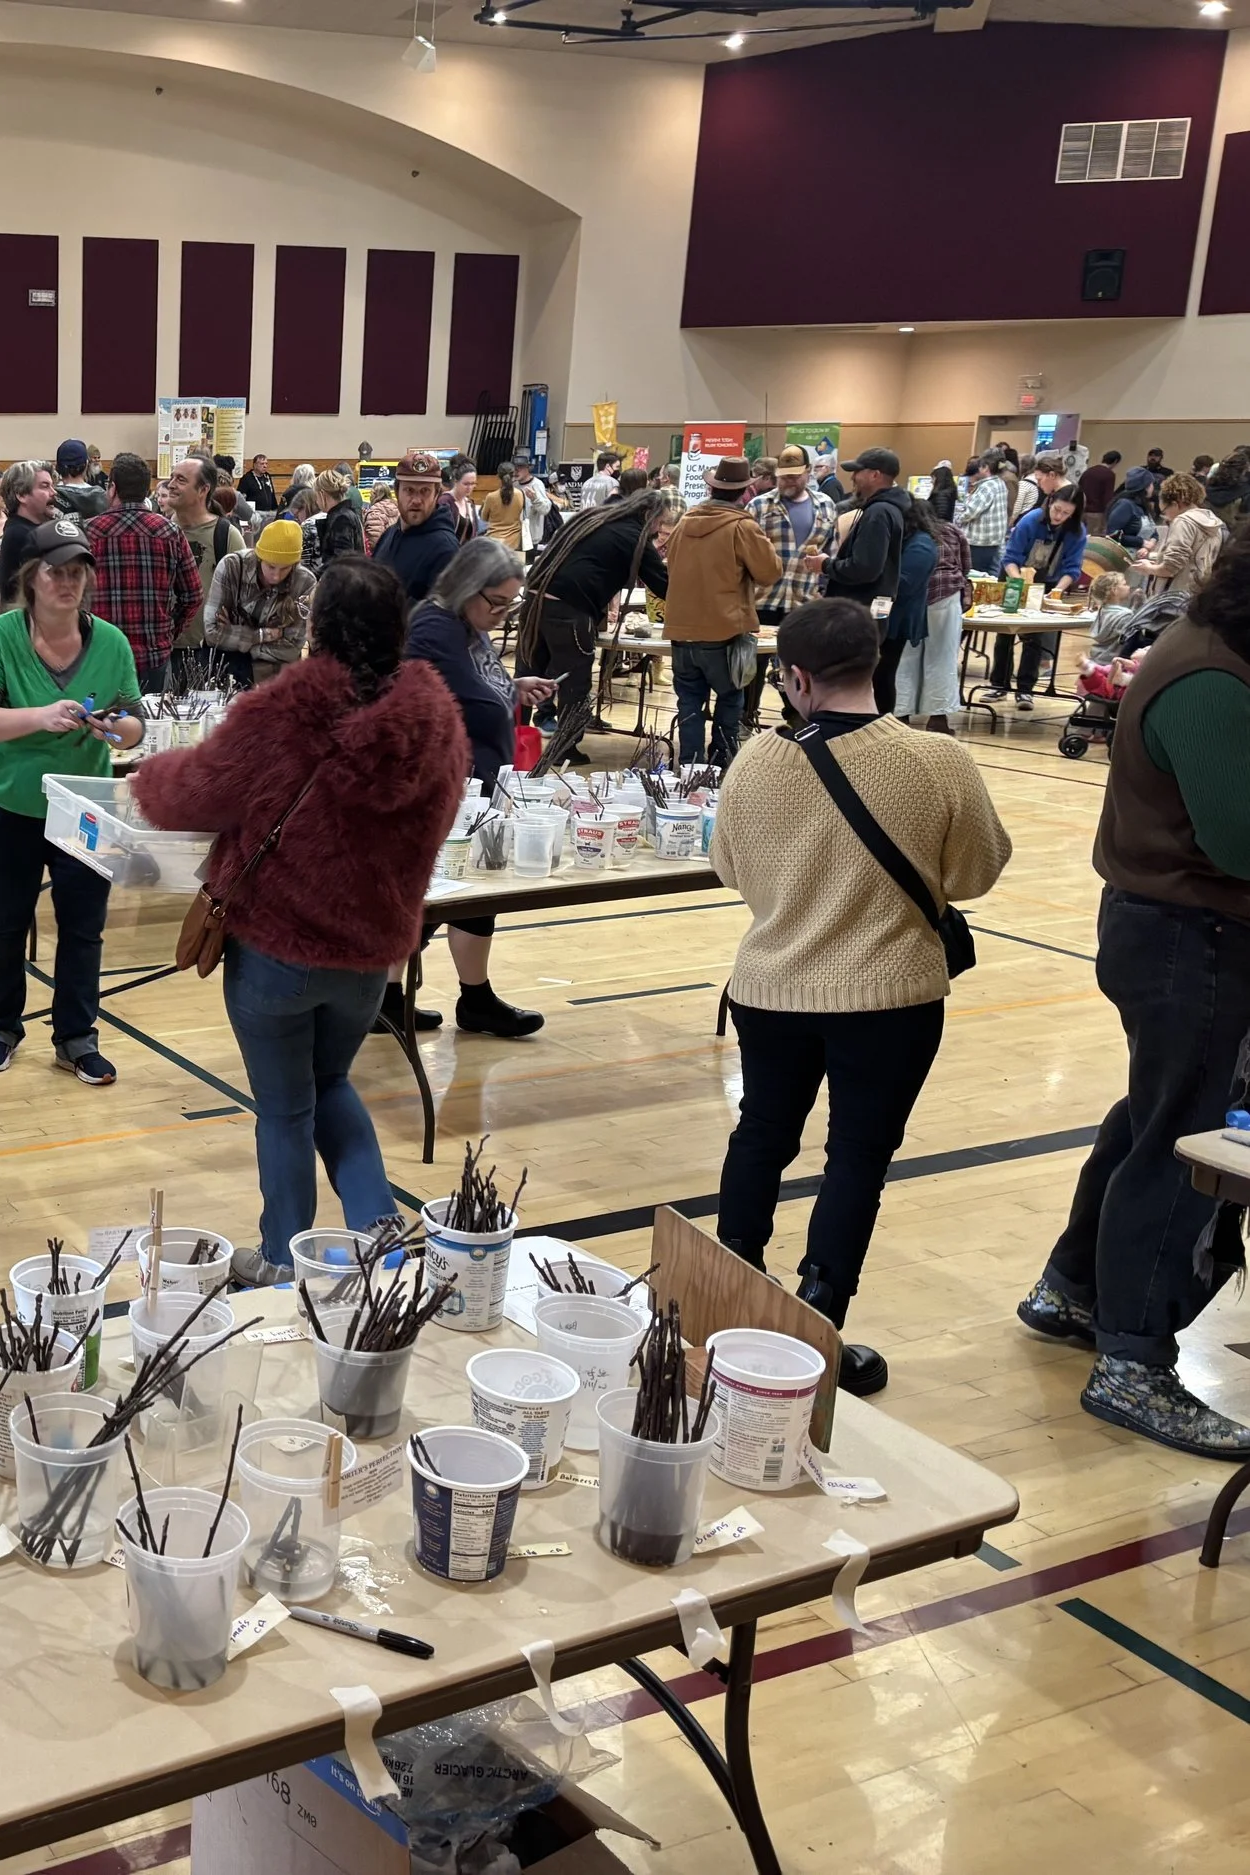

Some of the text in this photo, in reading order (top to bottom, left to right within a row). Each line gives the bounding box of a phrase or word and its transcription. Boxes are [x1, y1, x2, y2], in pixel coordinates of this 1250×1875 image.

[686, 464, 697, 472] UC
[577, 829, 603, 838] STRAUS
[368, 1446, 402, 1469] PERFECTION
[454, 1491, 481, 1499] Nutrition
[732, 1526, 747, 1539] CA
[254, 1619, 267, 1634] CA
[333, 1614, 359, 1632] Sharpie
[382, 1756, 413, 1774] 7.26kg
[435, 1762, 528, 1781] ARCTIC GLACIER
[344, 1779, 356, 1792] on
[403, 1776, 414, 1785] 16
[401, 1788, 413, 1798] NE
